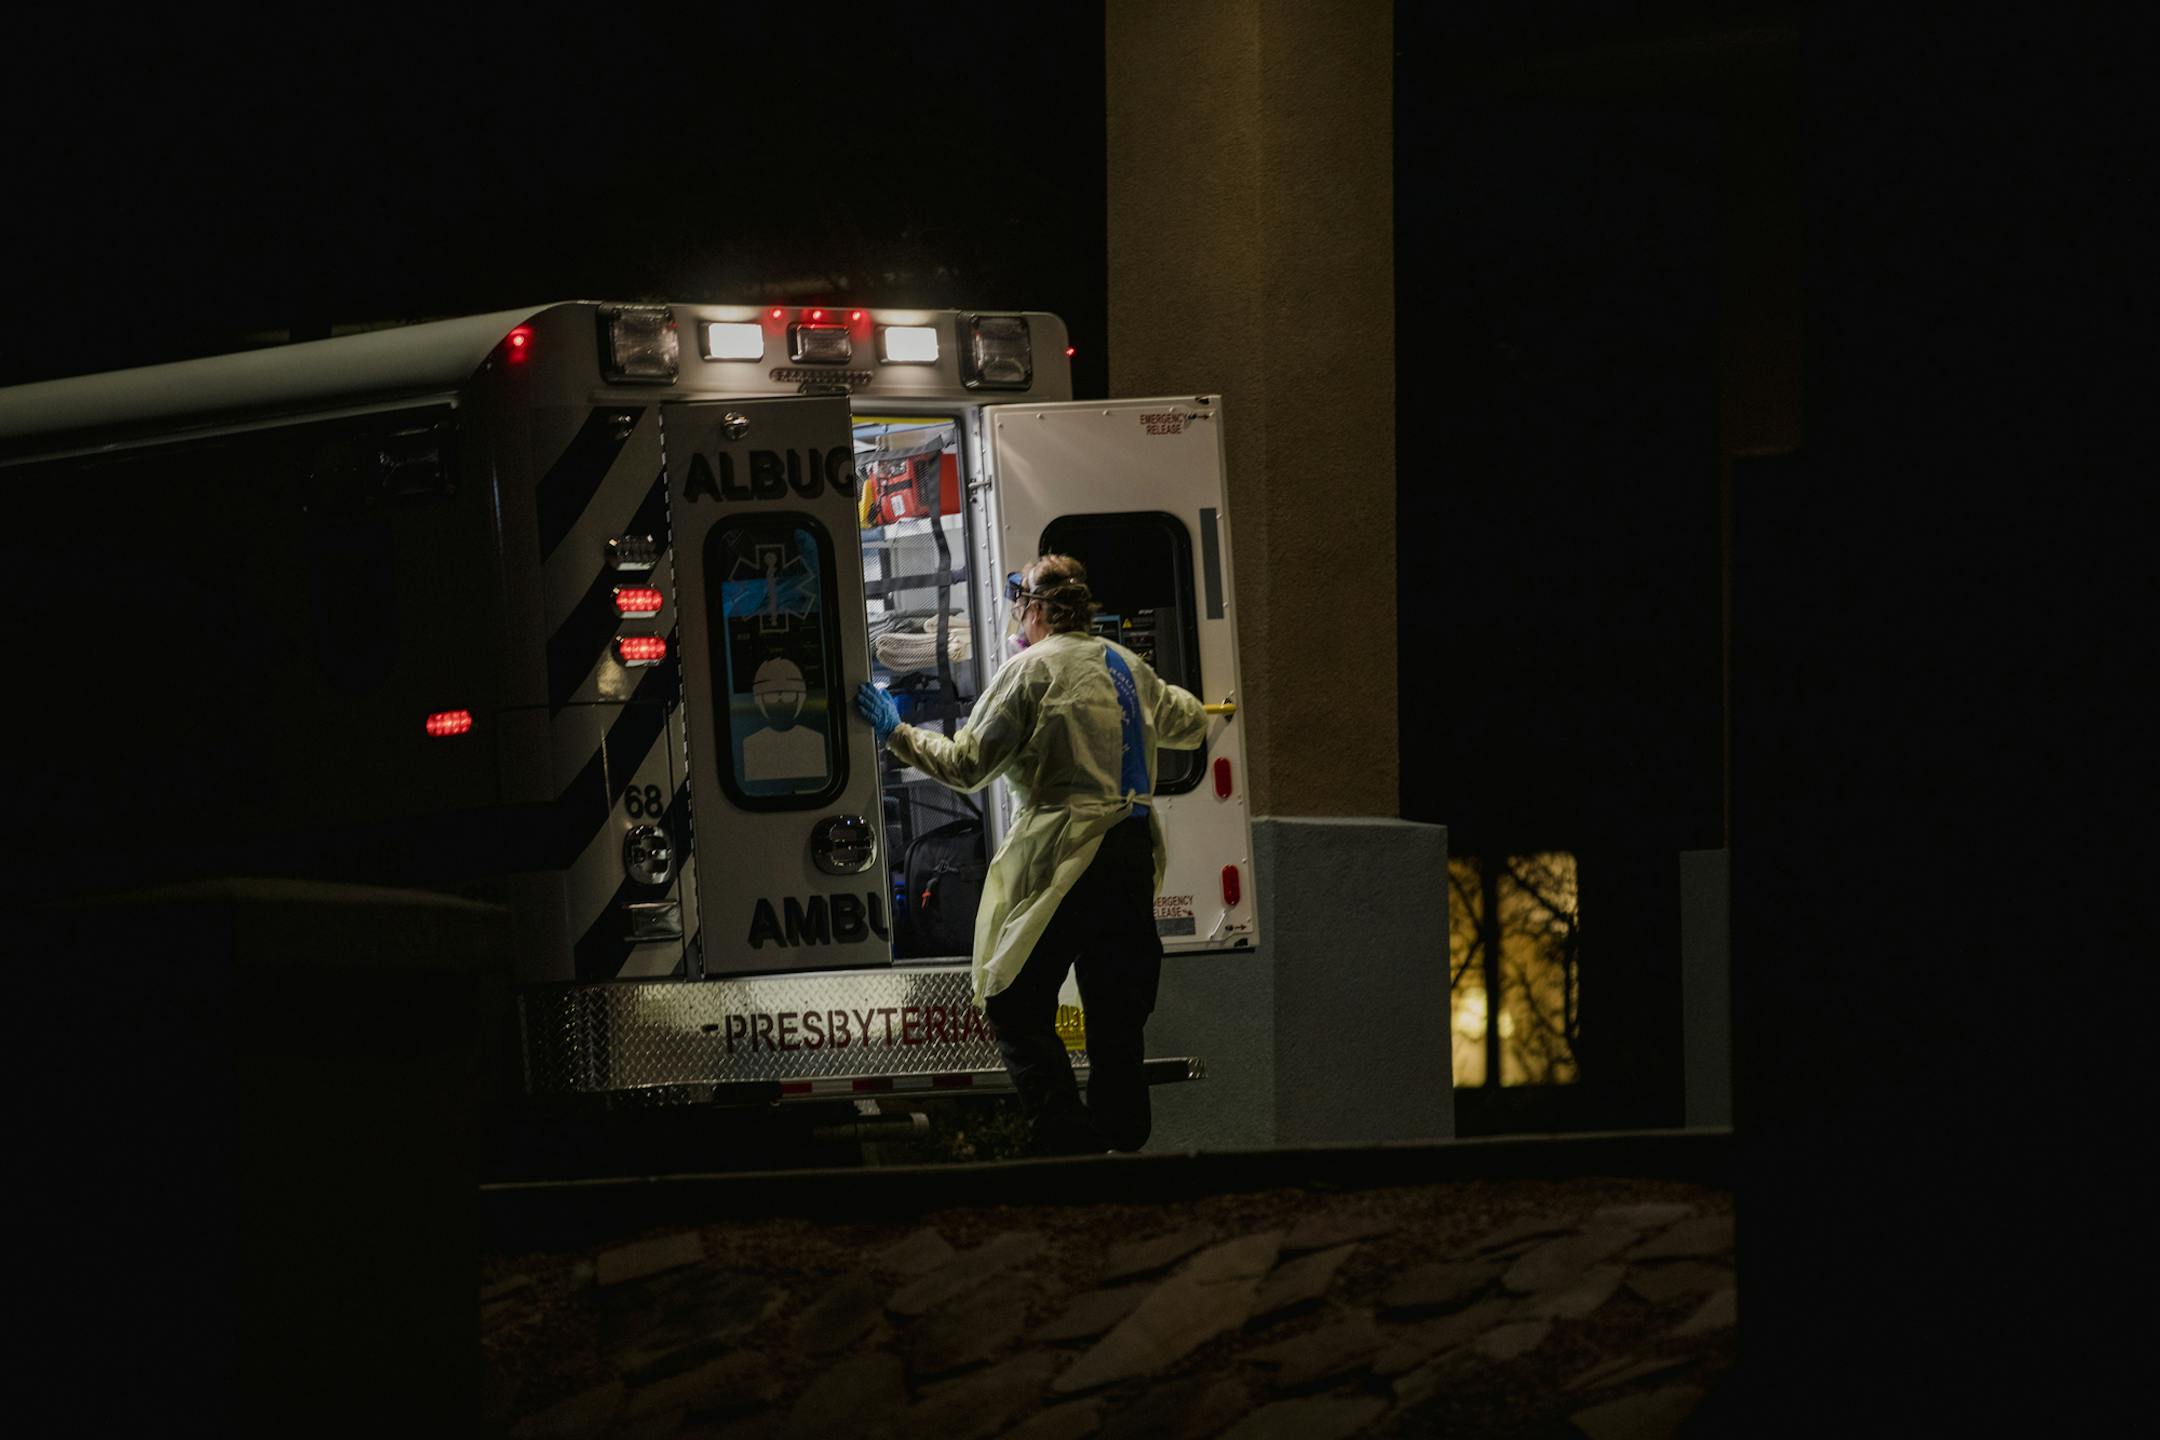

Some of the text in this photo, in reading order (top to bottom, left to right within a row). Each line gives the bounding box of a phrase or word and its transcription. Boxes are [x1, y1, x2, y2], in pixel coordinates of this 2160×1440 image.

[1140, 413, 1188, 424] EMERGENCY
[1146, 424, 1182, 435] RELEASE
[624, 784, 663, 819] 68
[1153, 895, 1193, 908] ERGENCY
[1153, 907, 1182, 918] ELEASE
